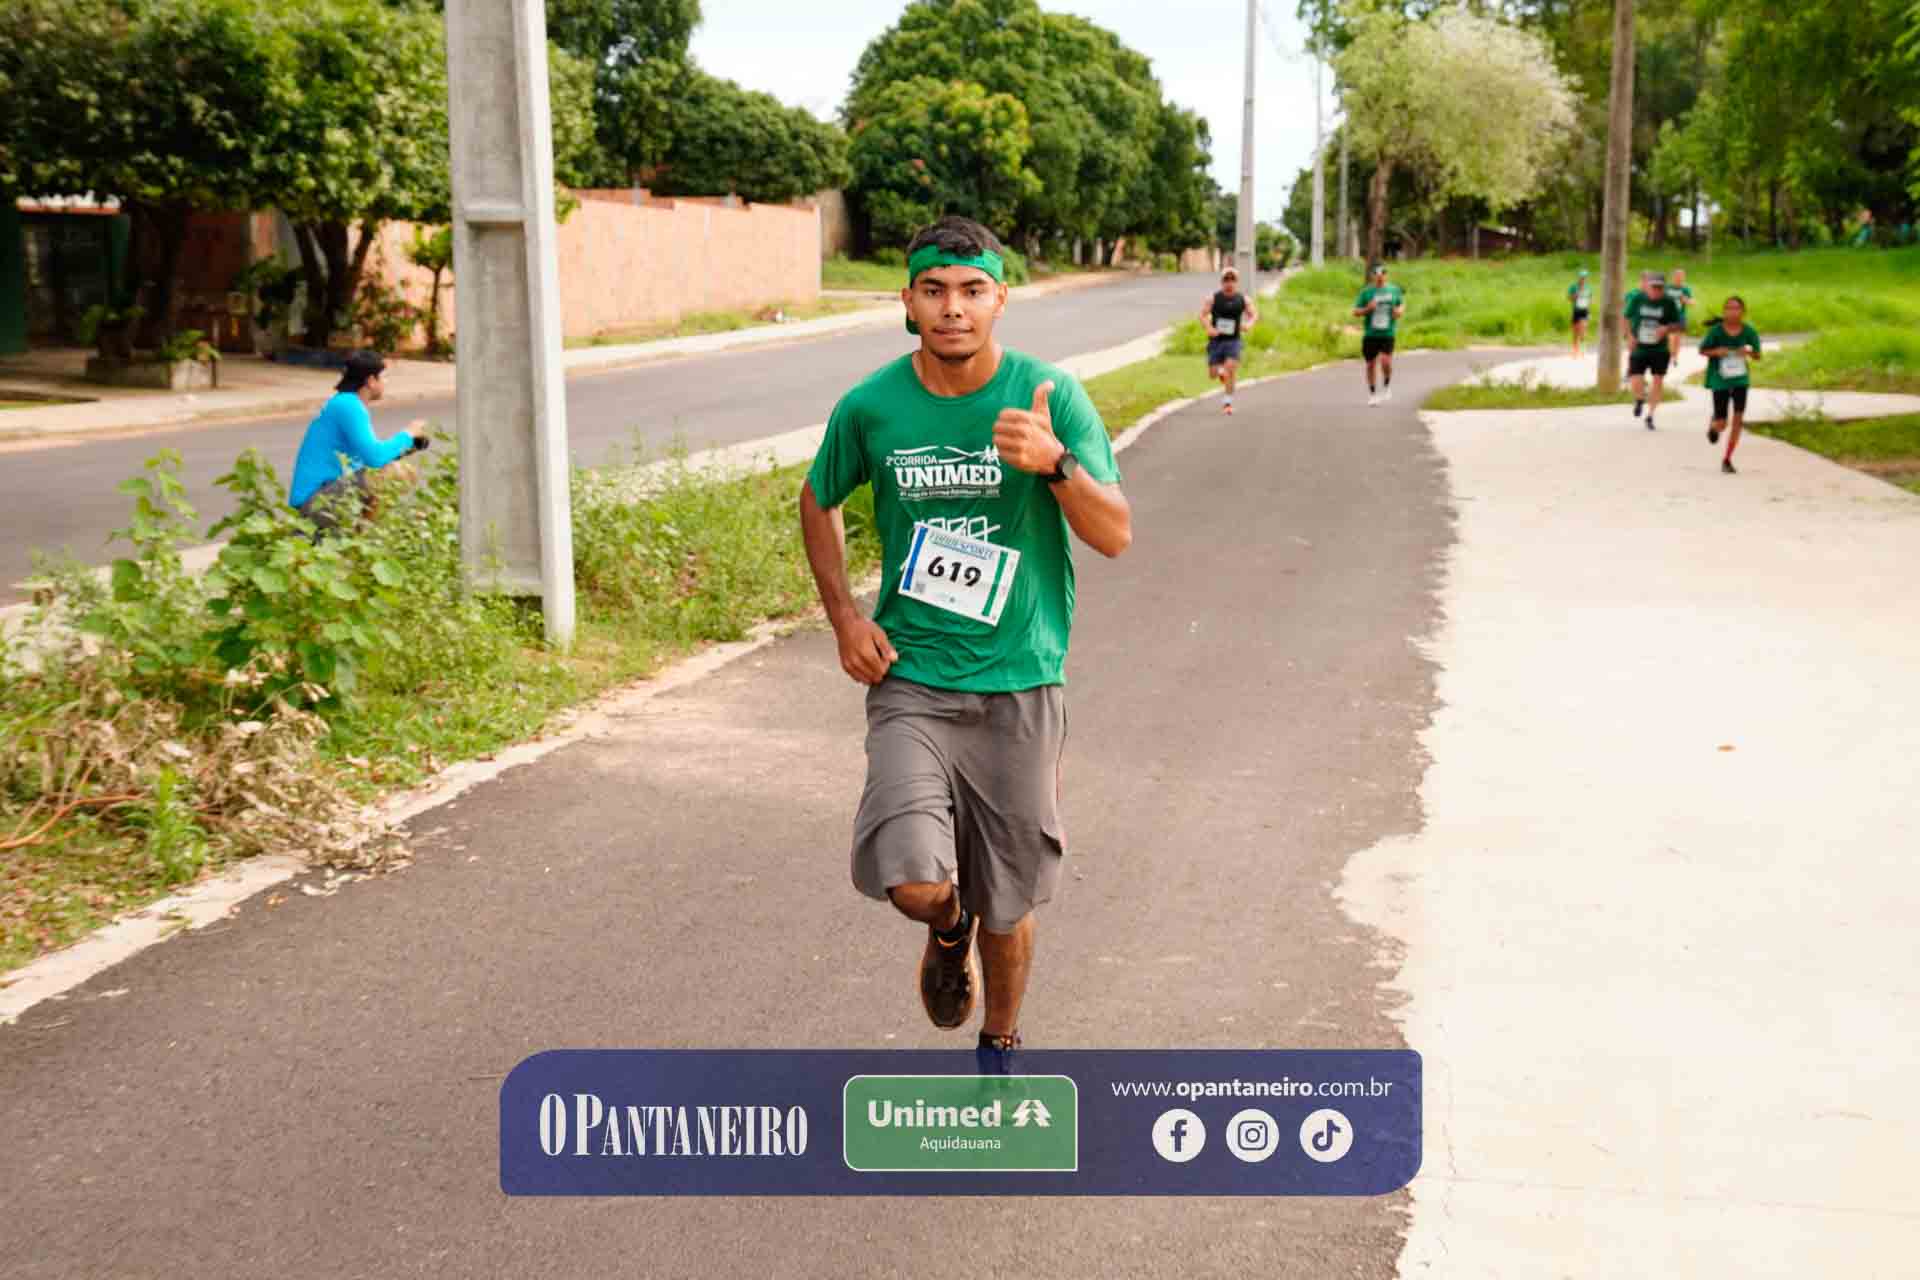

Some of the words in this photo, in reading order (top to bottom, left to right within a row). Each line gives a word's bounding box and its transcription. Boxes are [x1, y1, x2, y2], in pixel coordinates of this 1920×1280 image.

[894, 455, 937, 466] CORRIDA
[894, 464, 1002, 488] UNIMED
[927, 556, 982, 587] 619
